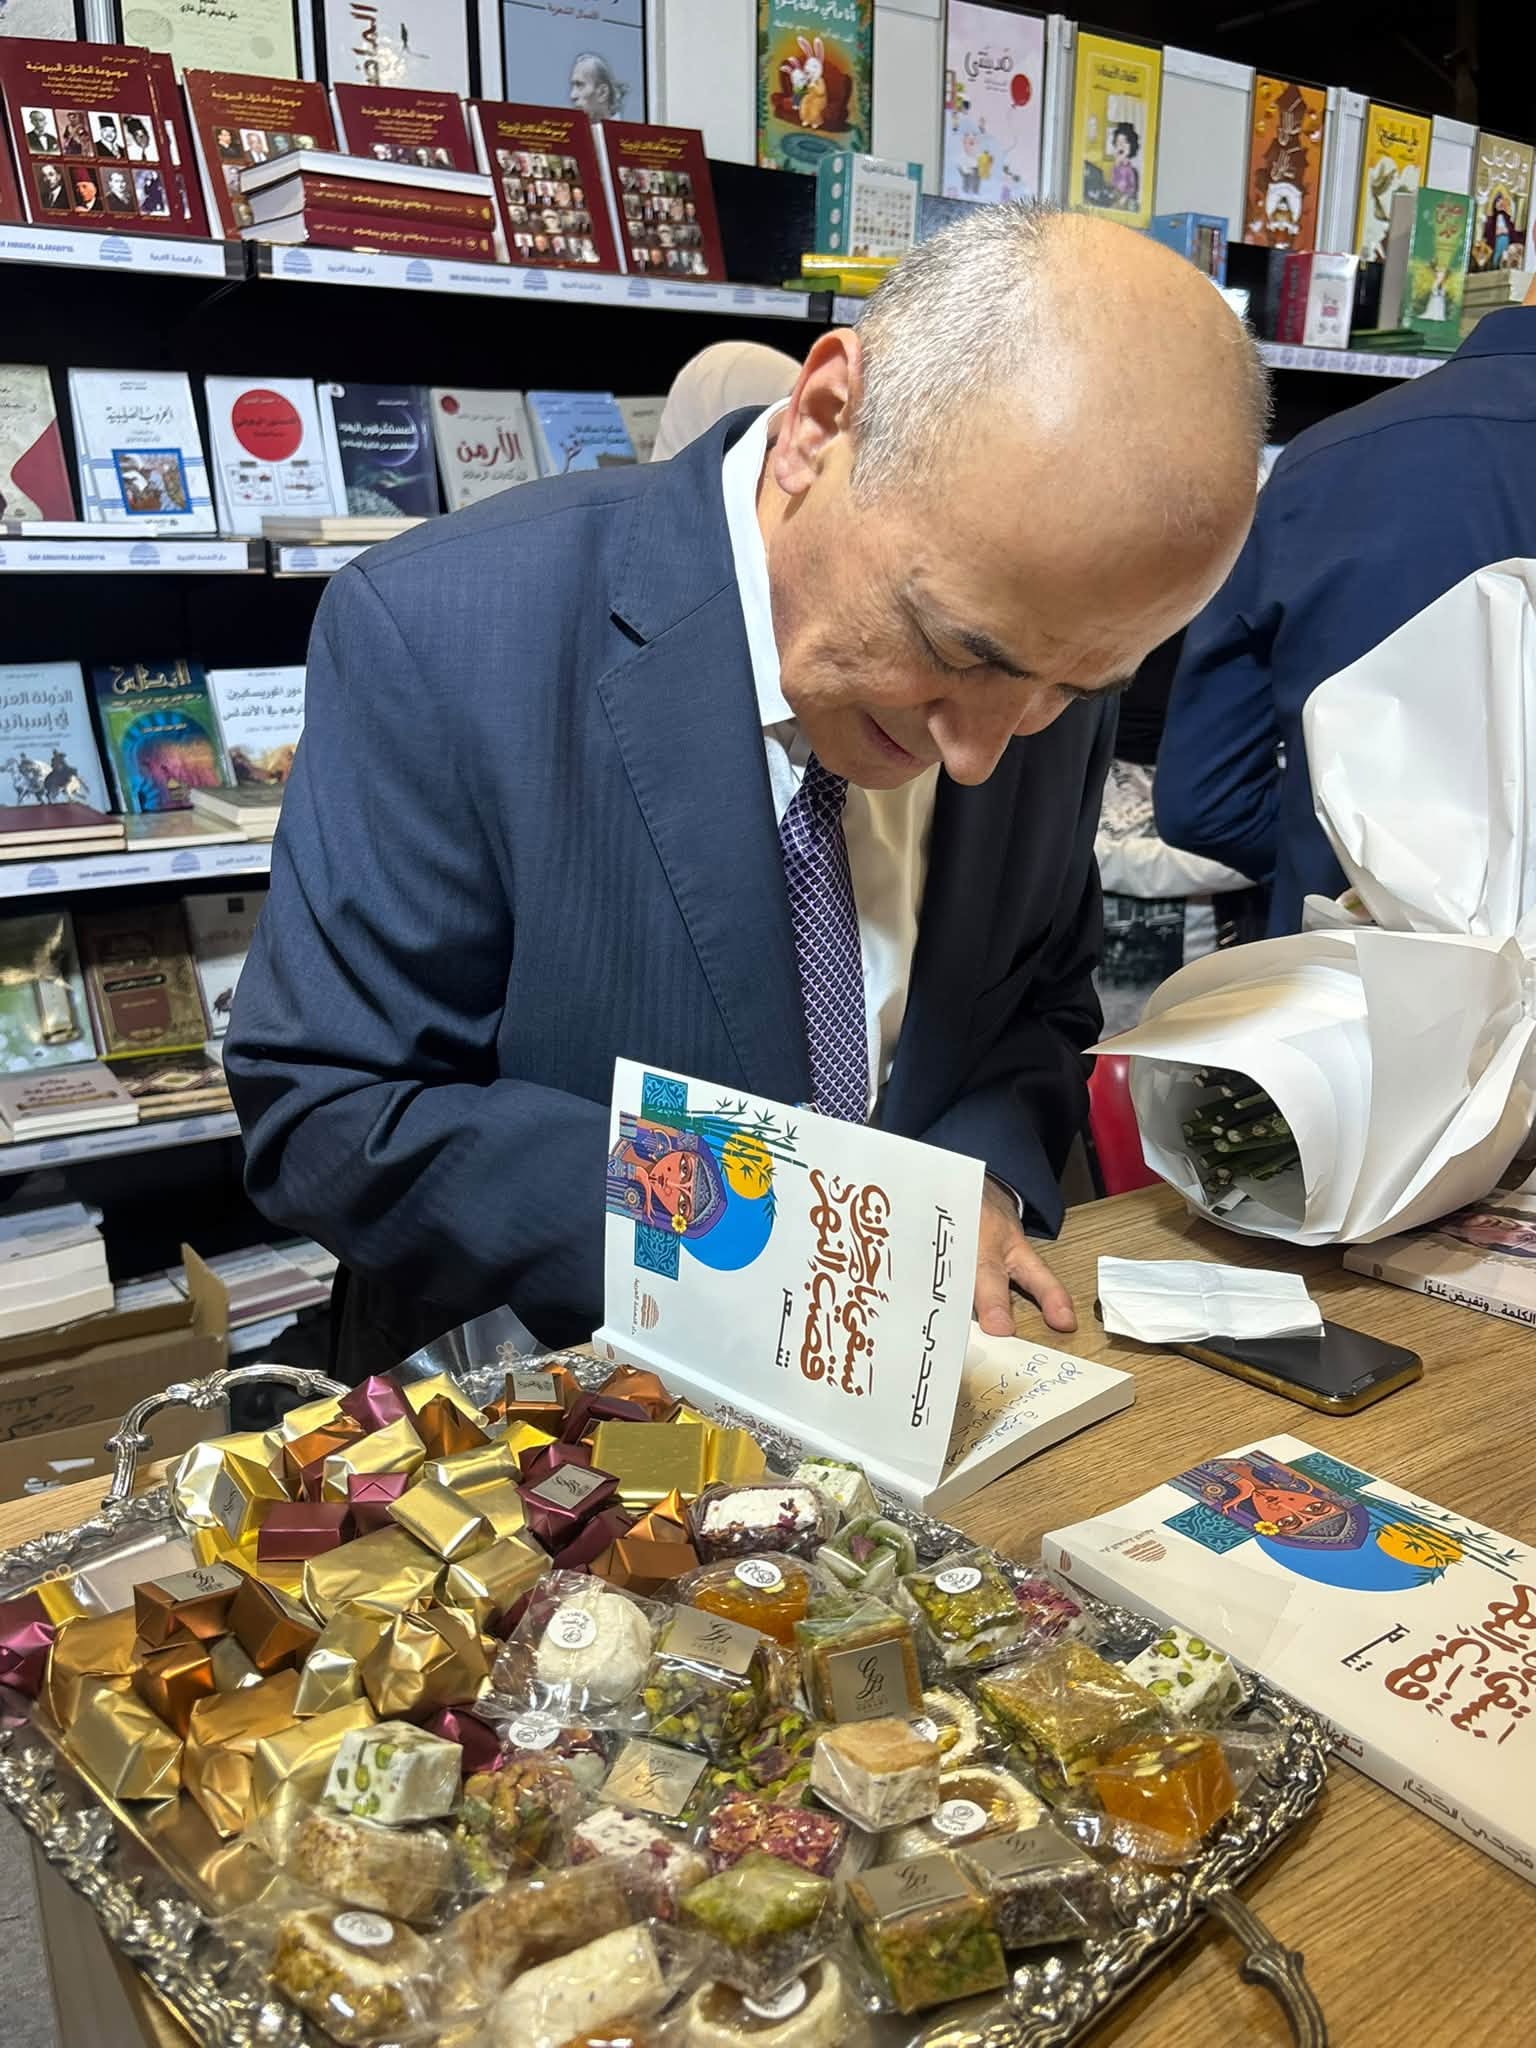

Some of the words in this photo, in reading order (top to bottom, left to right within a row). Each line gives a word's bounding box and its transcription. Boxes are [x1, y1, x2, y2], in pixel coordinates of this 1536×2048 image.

[456, 425, 523, 467] الأرمن
[32, 685, 73, 706] الدولة
[775, 1287, 793, 1369] شعر
[1340, 1622, 1411, 1672] شعر
